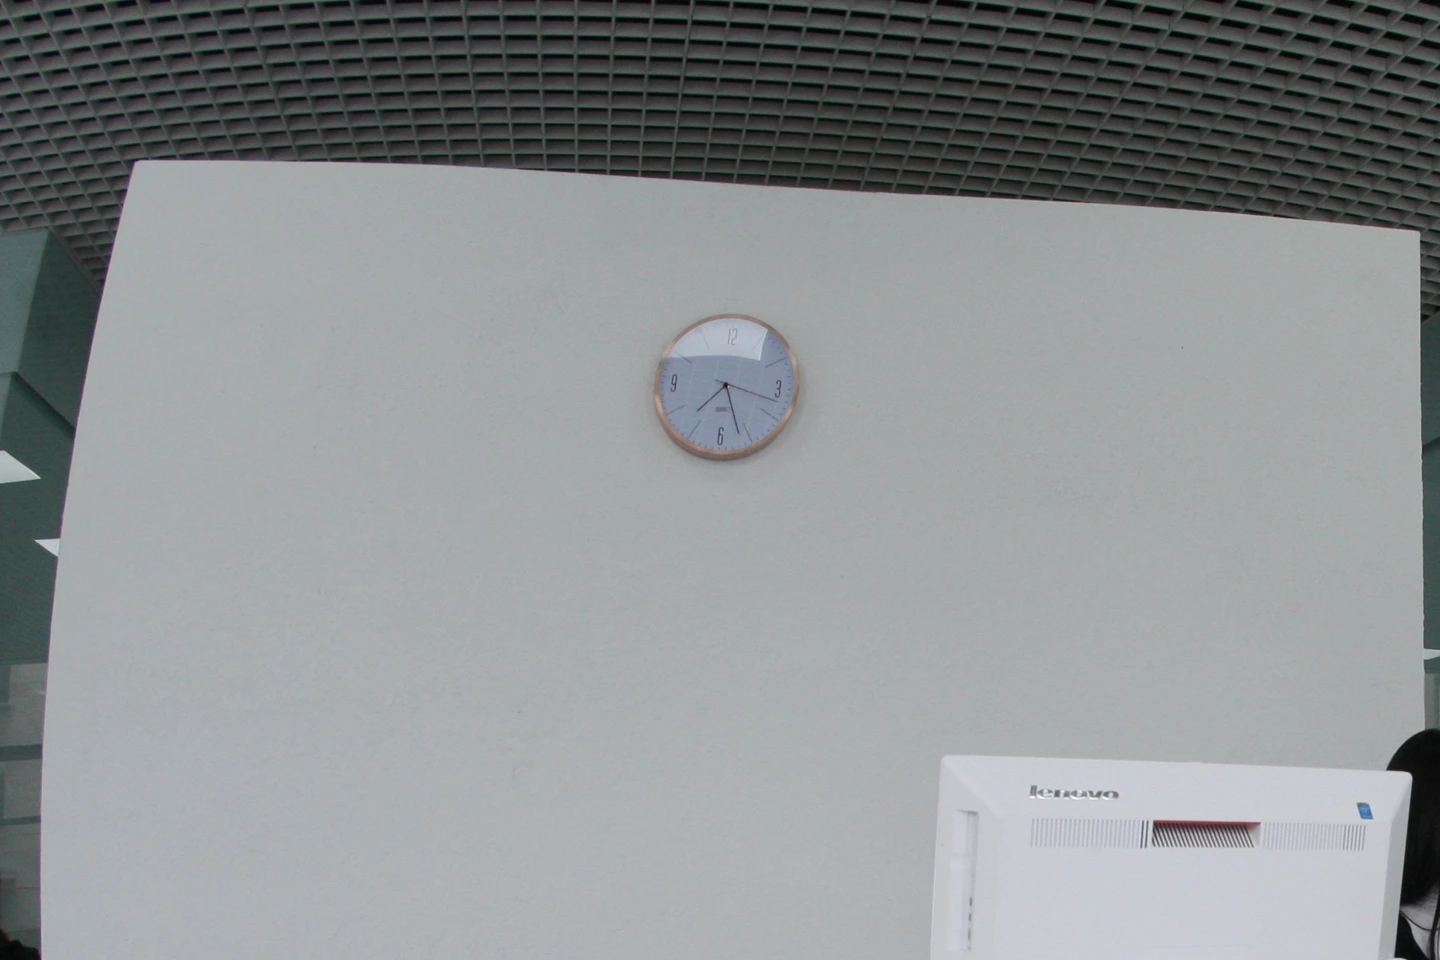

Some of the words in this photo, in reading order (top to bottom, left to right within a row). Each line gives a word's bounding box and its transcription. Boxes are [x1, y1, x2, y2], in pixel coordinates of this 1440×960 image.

[727, 327, 738, 346] 12
[670, 373, 678, 393] 9
[774, 379, 782, 398] 3
[717, 427, 724, 446] 6
[1029, 785, 1120, 801] lenovo
